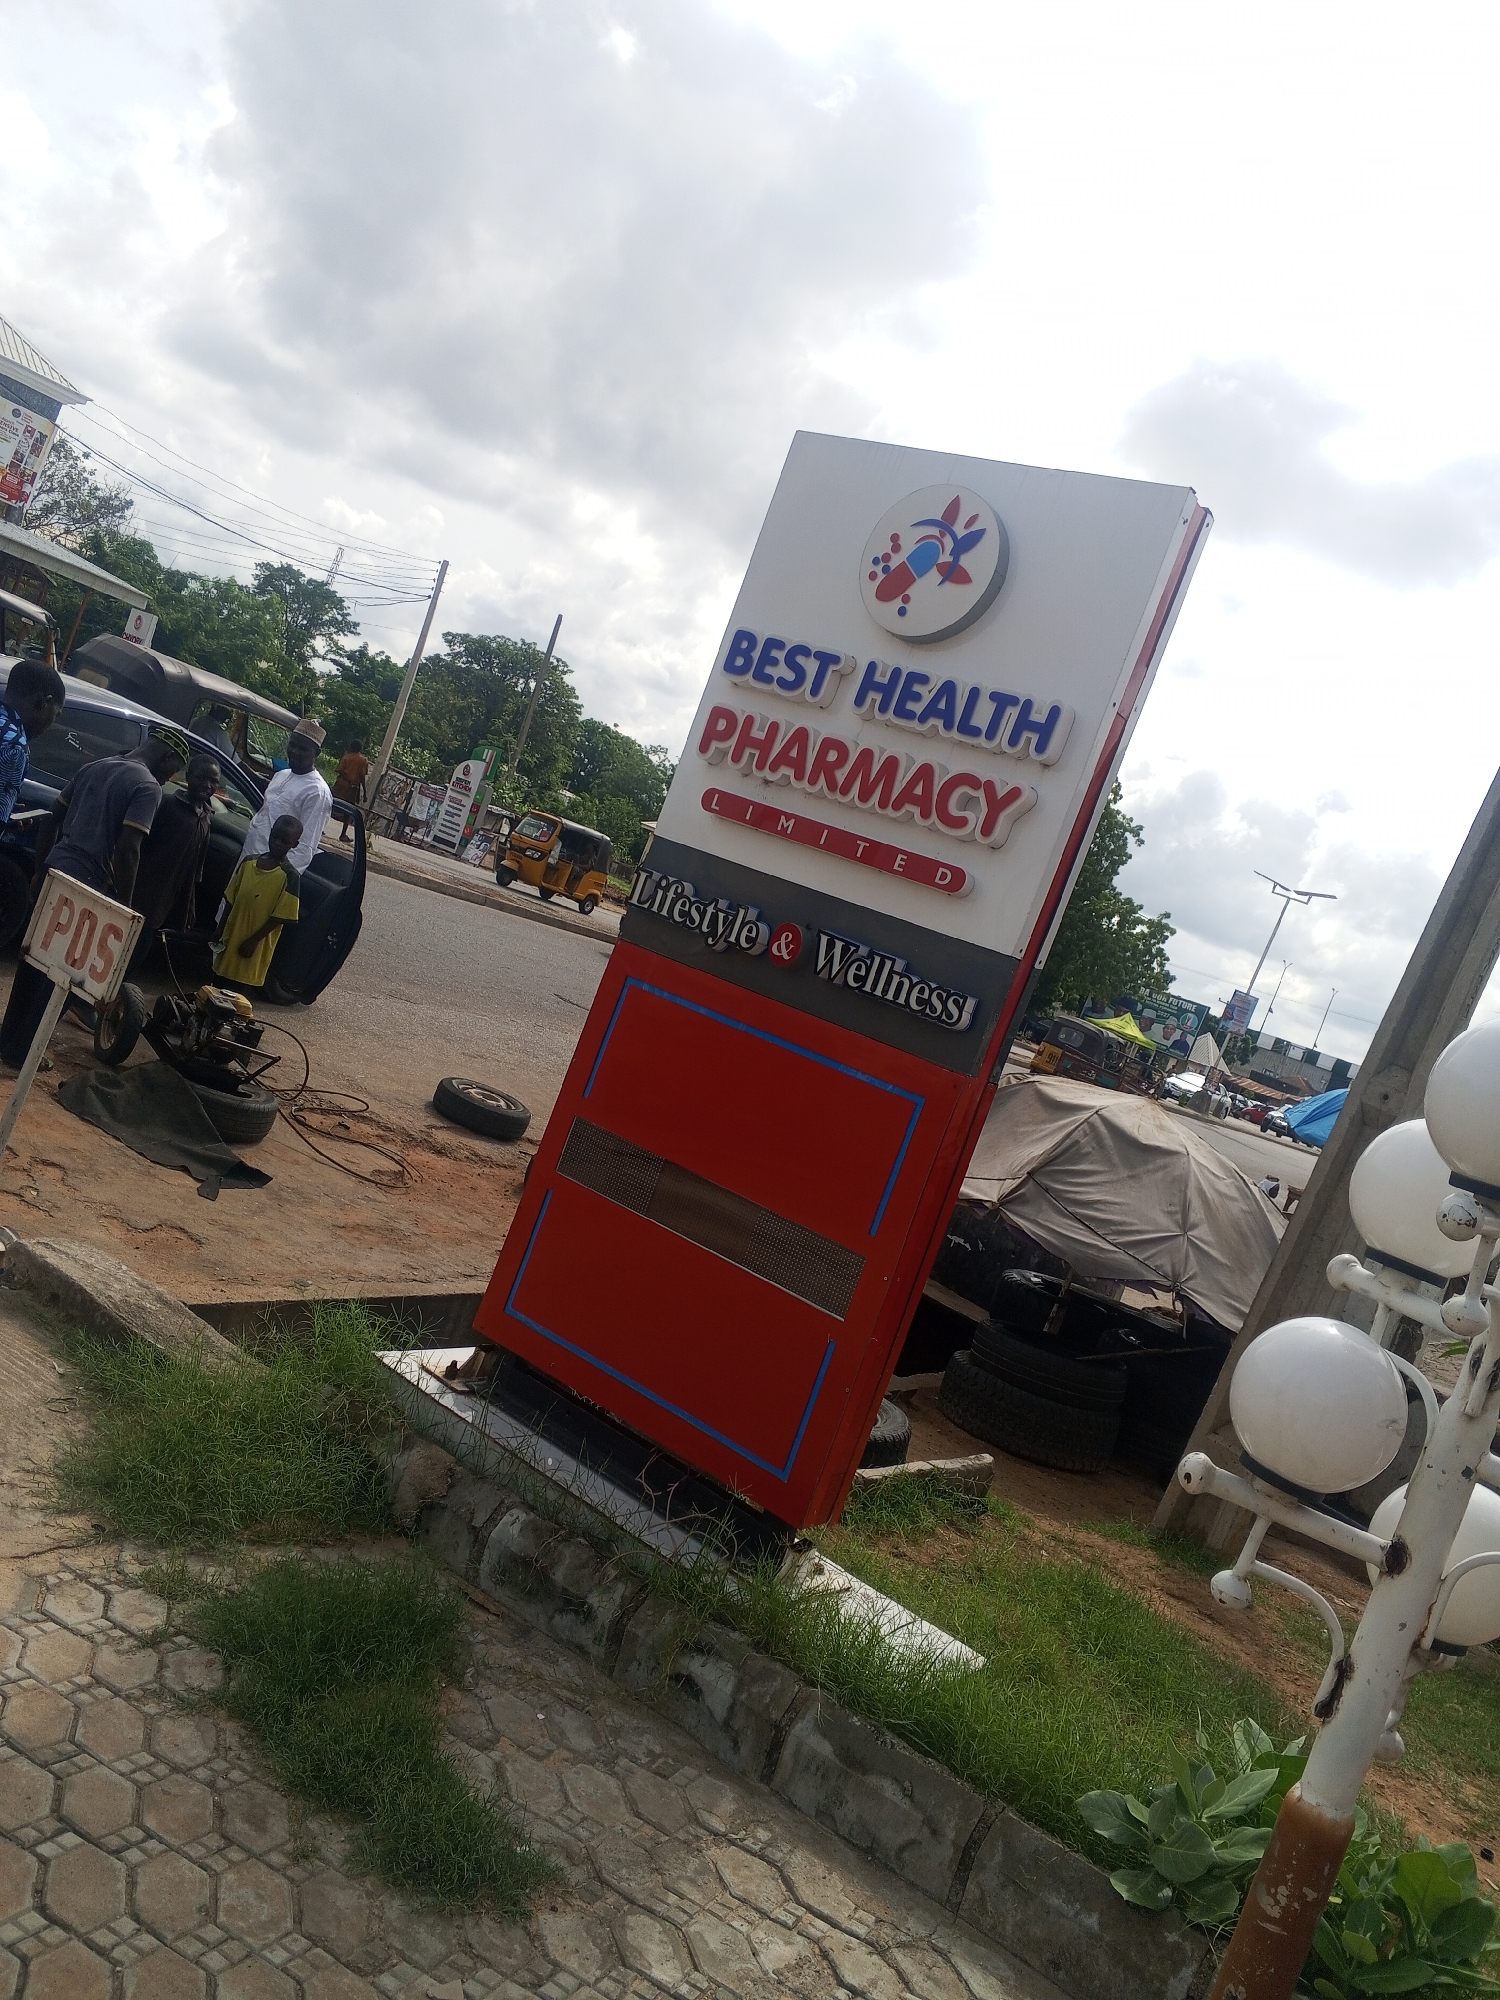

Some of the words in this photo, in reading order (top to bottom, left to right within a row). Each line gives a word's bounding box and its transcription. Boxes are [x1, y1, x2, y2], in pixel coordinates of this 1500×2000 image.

[724, 629, 841, 698] BEST
[853, 660, 1061, 755] HEALTH
[698, 705, 1022, 838] PHARMACY
[710, 793, 952, 886] LIMITED
[40, 893, 124, 985] POS
[627, 869, 760, 949] Lifestyle
[771, 931, 796, 960] &
[815, 931, 965, 1025] Wellness
[1167, 996, 1198, 1013] FUTURE
